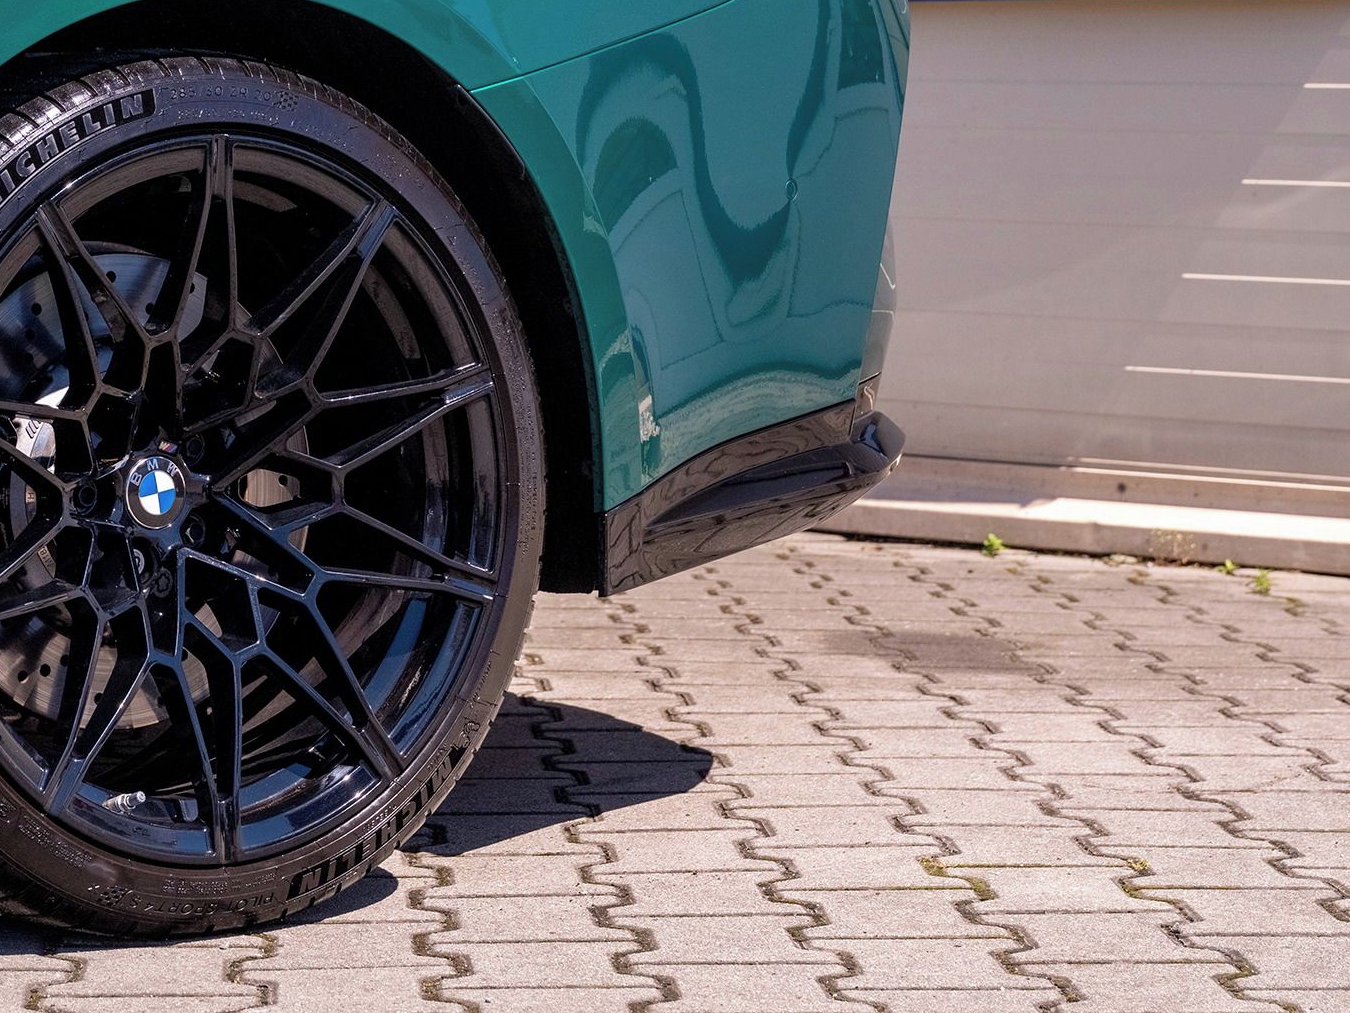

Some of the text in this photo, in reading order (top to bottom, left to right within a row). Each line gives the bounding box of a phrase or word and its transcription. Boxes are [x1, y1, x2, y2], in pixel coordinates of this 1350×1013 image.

[130, 458, 179, 486] BMW
[299, 757, 453, 889] MICHELIN
[154, 902, 219, 916] SPORT
[226, 892, 275, 912] PILOT
